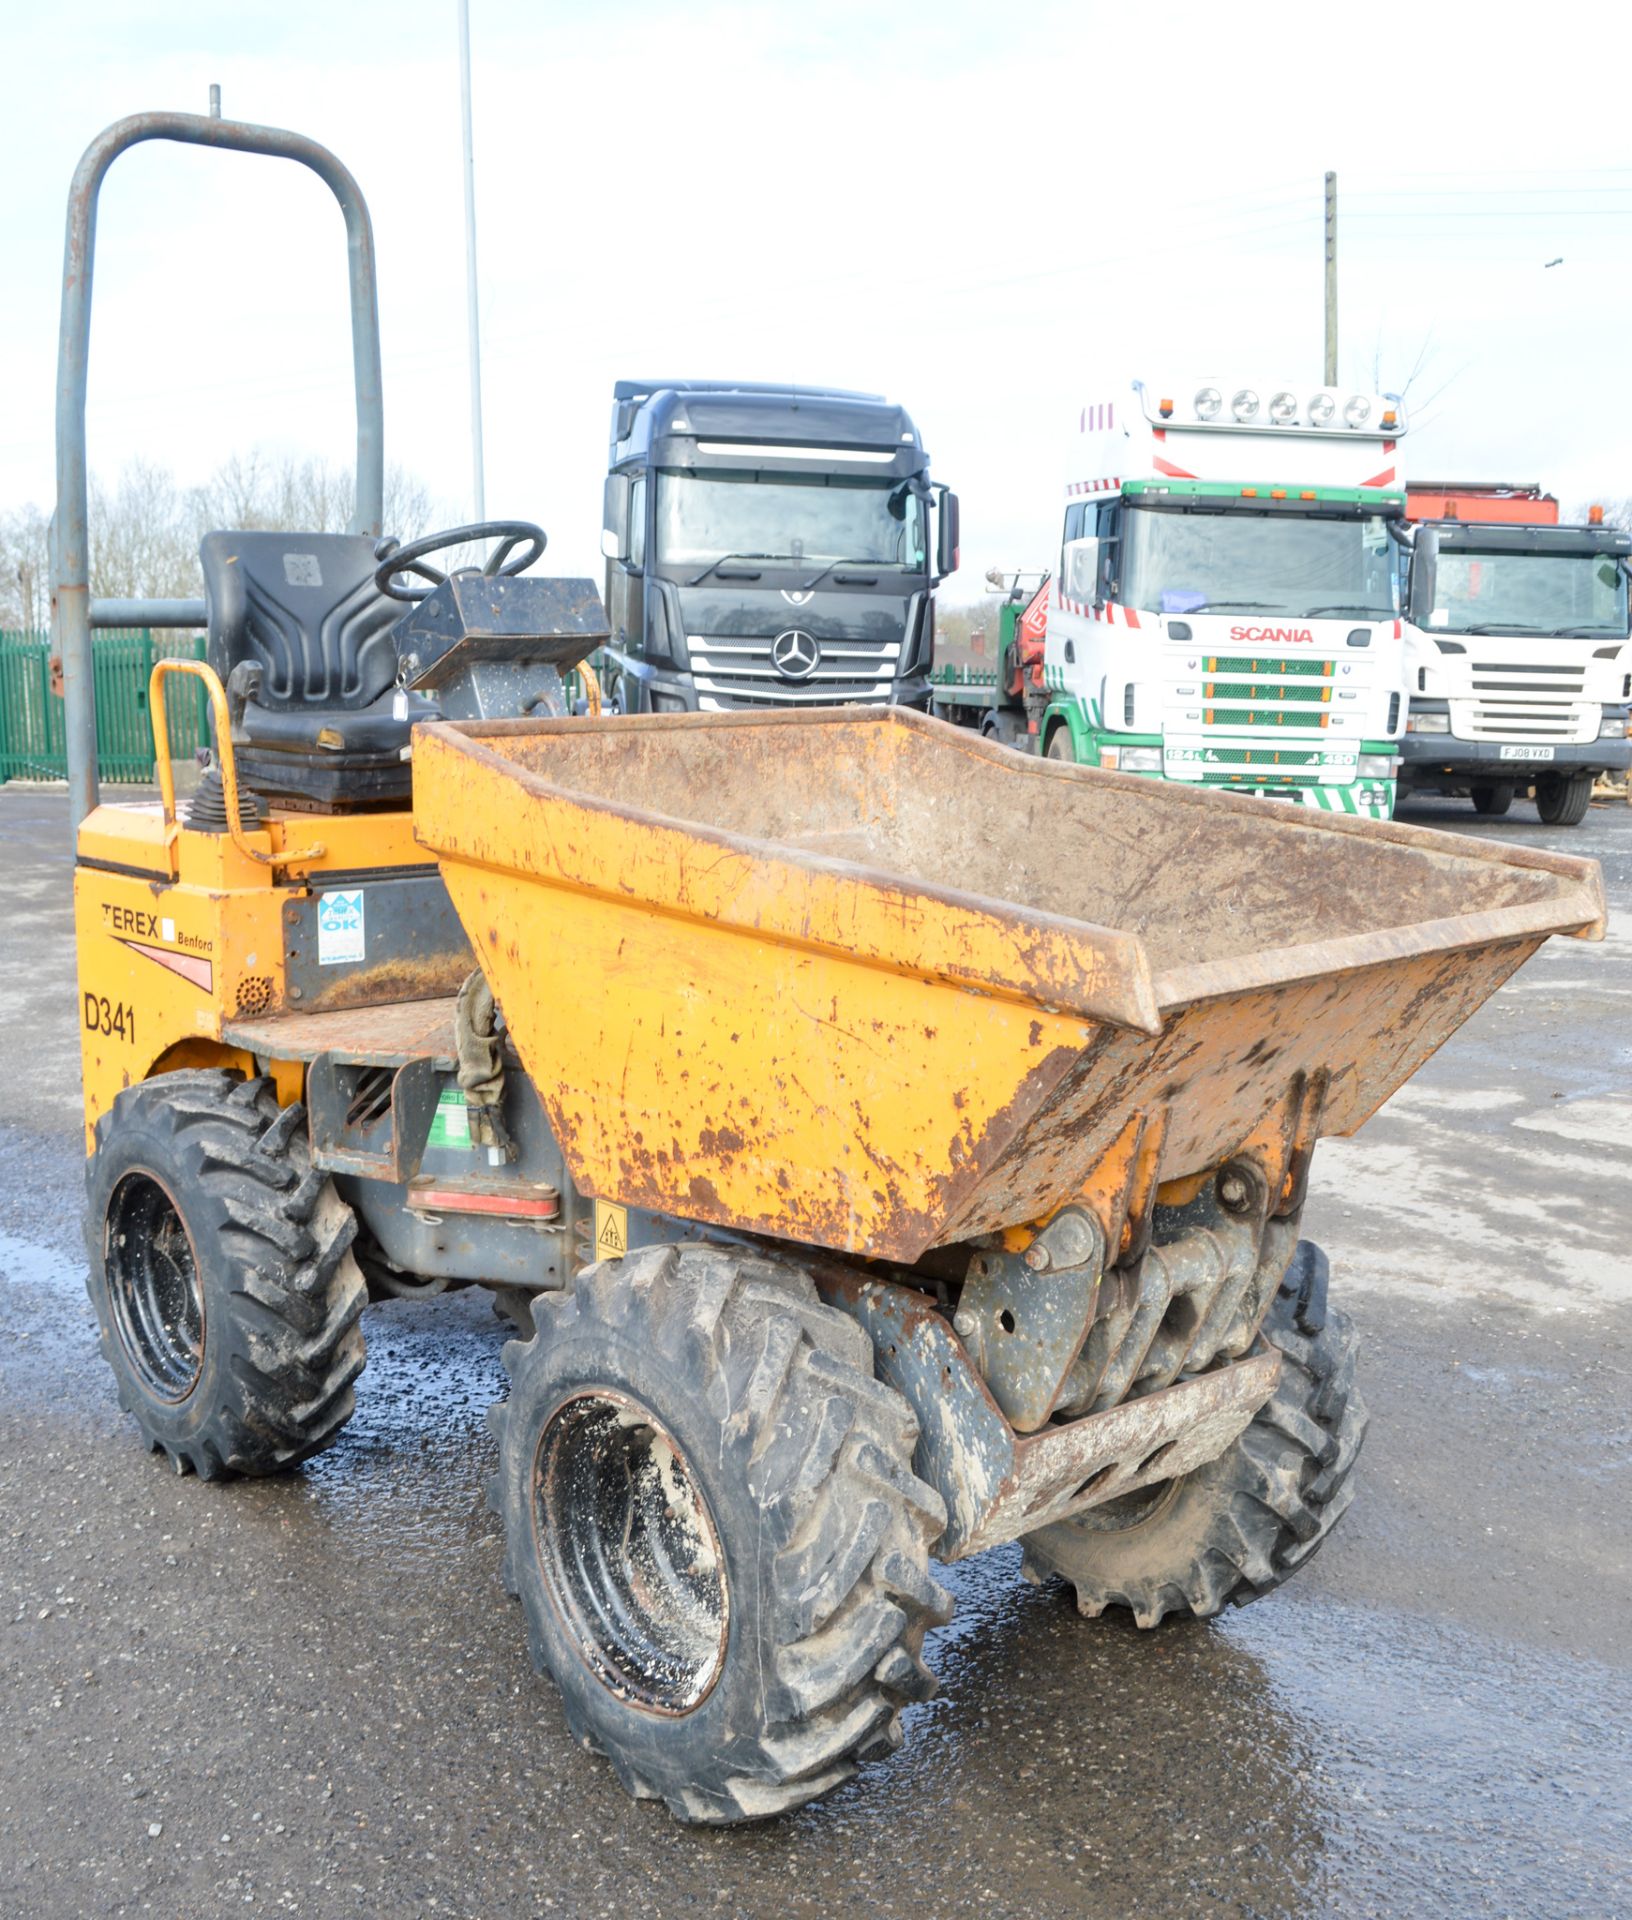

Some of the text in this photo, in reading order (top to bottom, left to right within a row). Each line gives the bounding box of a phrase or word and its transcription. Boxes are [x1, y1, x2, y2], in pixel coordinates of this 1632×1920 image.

[1230, 626, 1314, 643] SCANIA
[1324, 753, 1354, 765] 420
[101, 903, 159, 939] TEREX
[322, 920, 358, 931] OK
[84, 992, 135, 1045] D341
